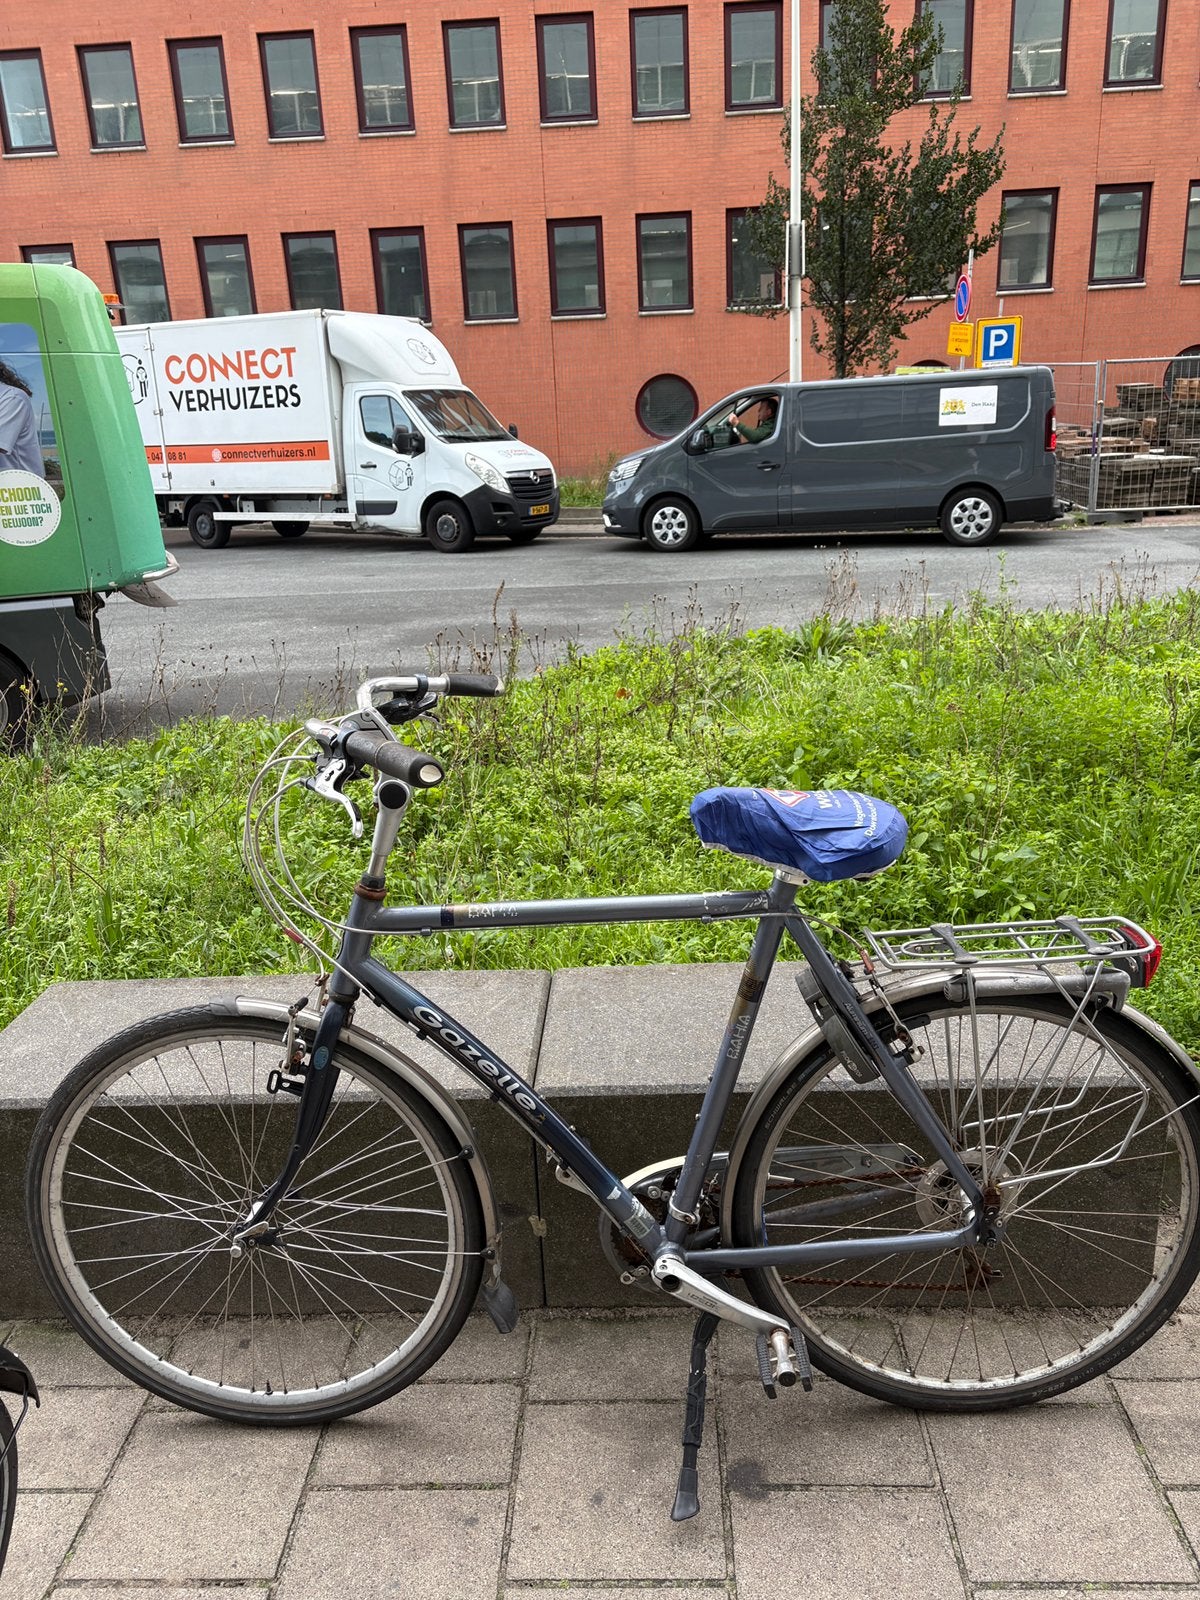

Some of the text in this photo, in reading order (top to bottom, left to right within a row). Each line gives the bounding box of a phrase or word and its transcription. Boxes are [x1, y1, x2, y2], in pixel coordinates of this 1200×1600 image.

[989, 329, 1008, 357] P
[165, 347, 296, 385] CONNECT
[169, 384, 301, 412] VERHUIZERS
[167, 452, 177, 460] 08
[178, 451, 187, 460] 81
[221, 447, 316, 460] connectverhuizers.nl
[2, 516, 44, 528] GEWOON?
[14, 504, 29, 515] WE
[30, 503, 52, 514] TOCH
[726, 1014, 751, 1060] BAHIA
[413, 1006, 537, 1112] Gazelle
